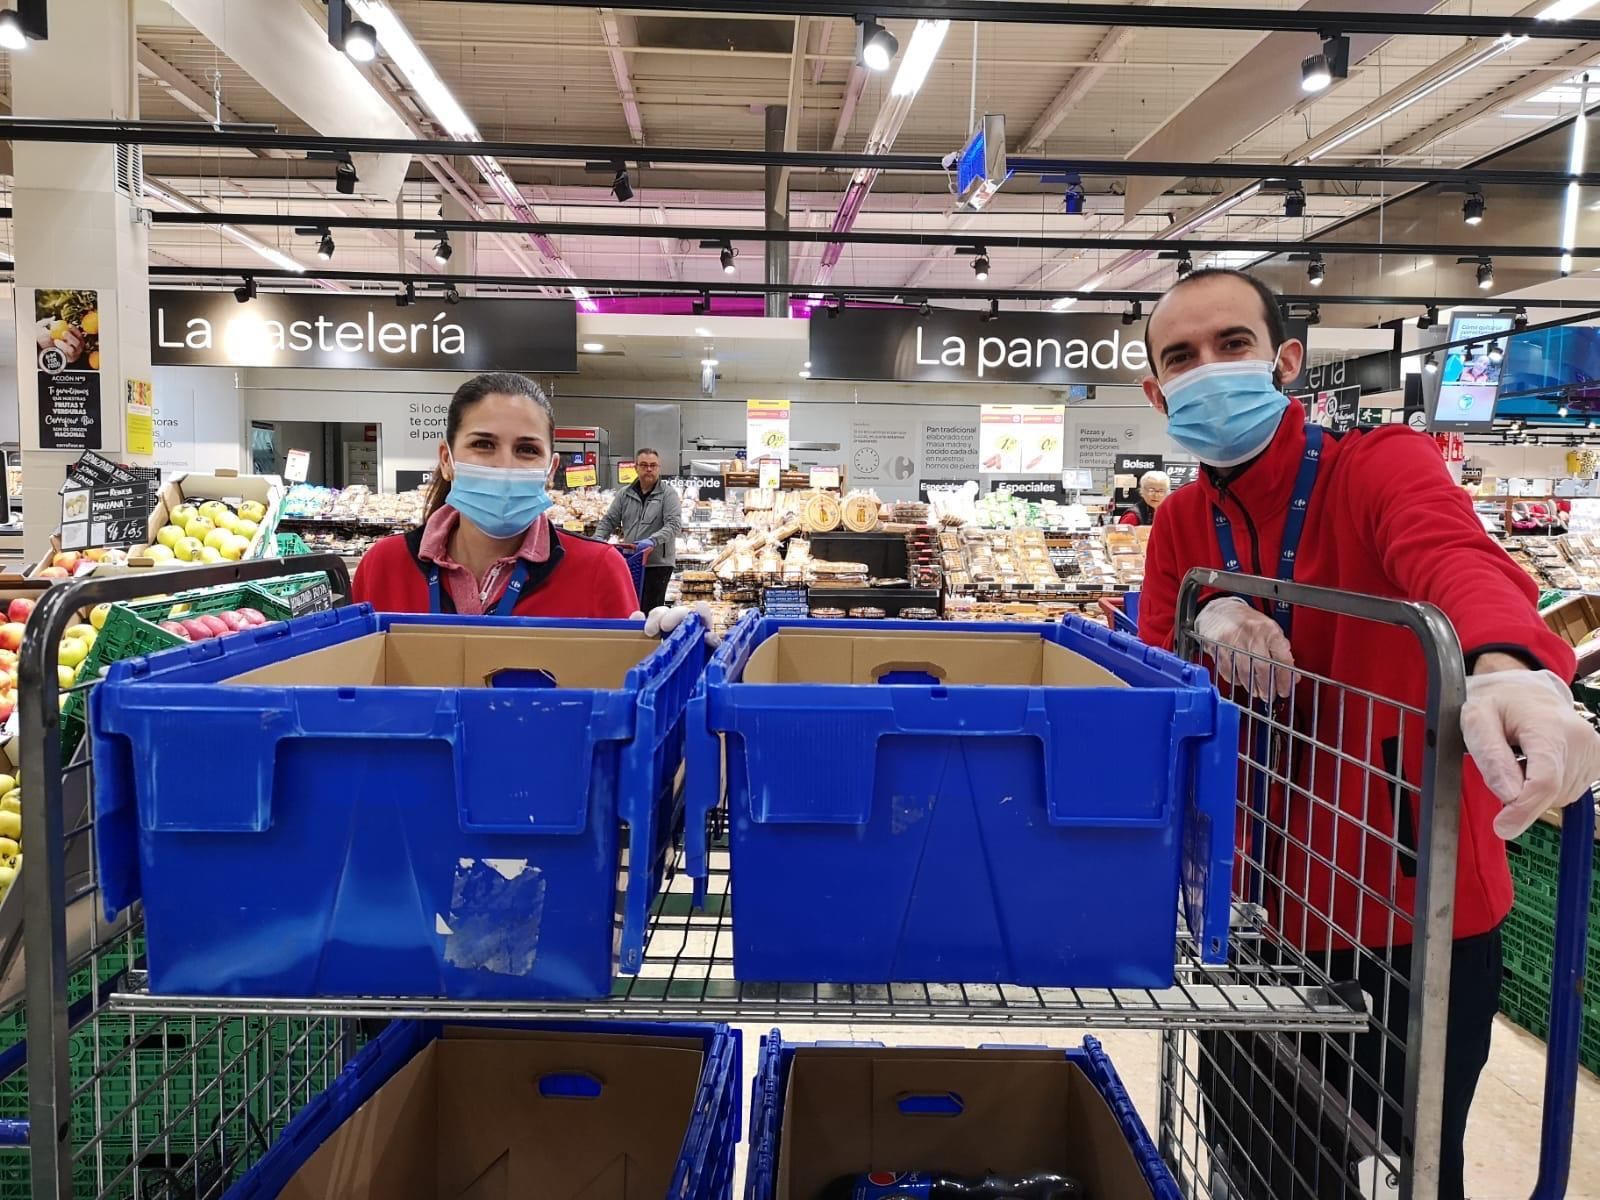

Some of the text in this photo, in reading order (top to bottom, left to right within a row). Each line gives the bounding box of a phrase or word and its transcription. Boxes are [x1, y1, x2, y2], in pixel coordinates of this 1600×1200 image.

[157, 308, 465, 355] La astelería
[916, 326, 1149, 377] La panade
[409, 403, 419, 413] Si
[421, 403, 432, 414] lo
[409, 417, 421, 426] te
[409, 429, 444, 440] el pan
[940, 426, 977, 434] tradicional
[1122, 459, 1155, 469] Bolsas
[686, 477, 721, 488] molde
[999, 482, 1055, 493] Especiales
